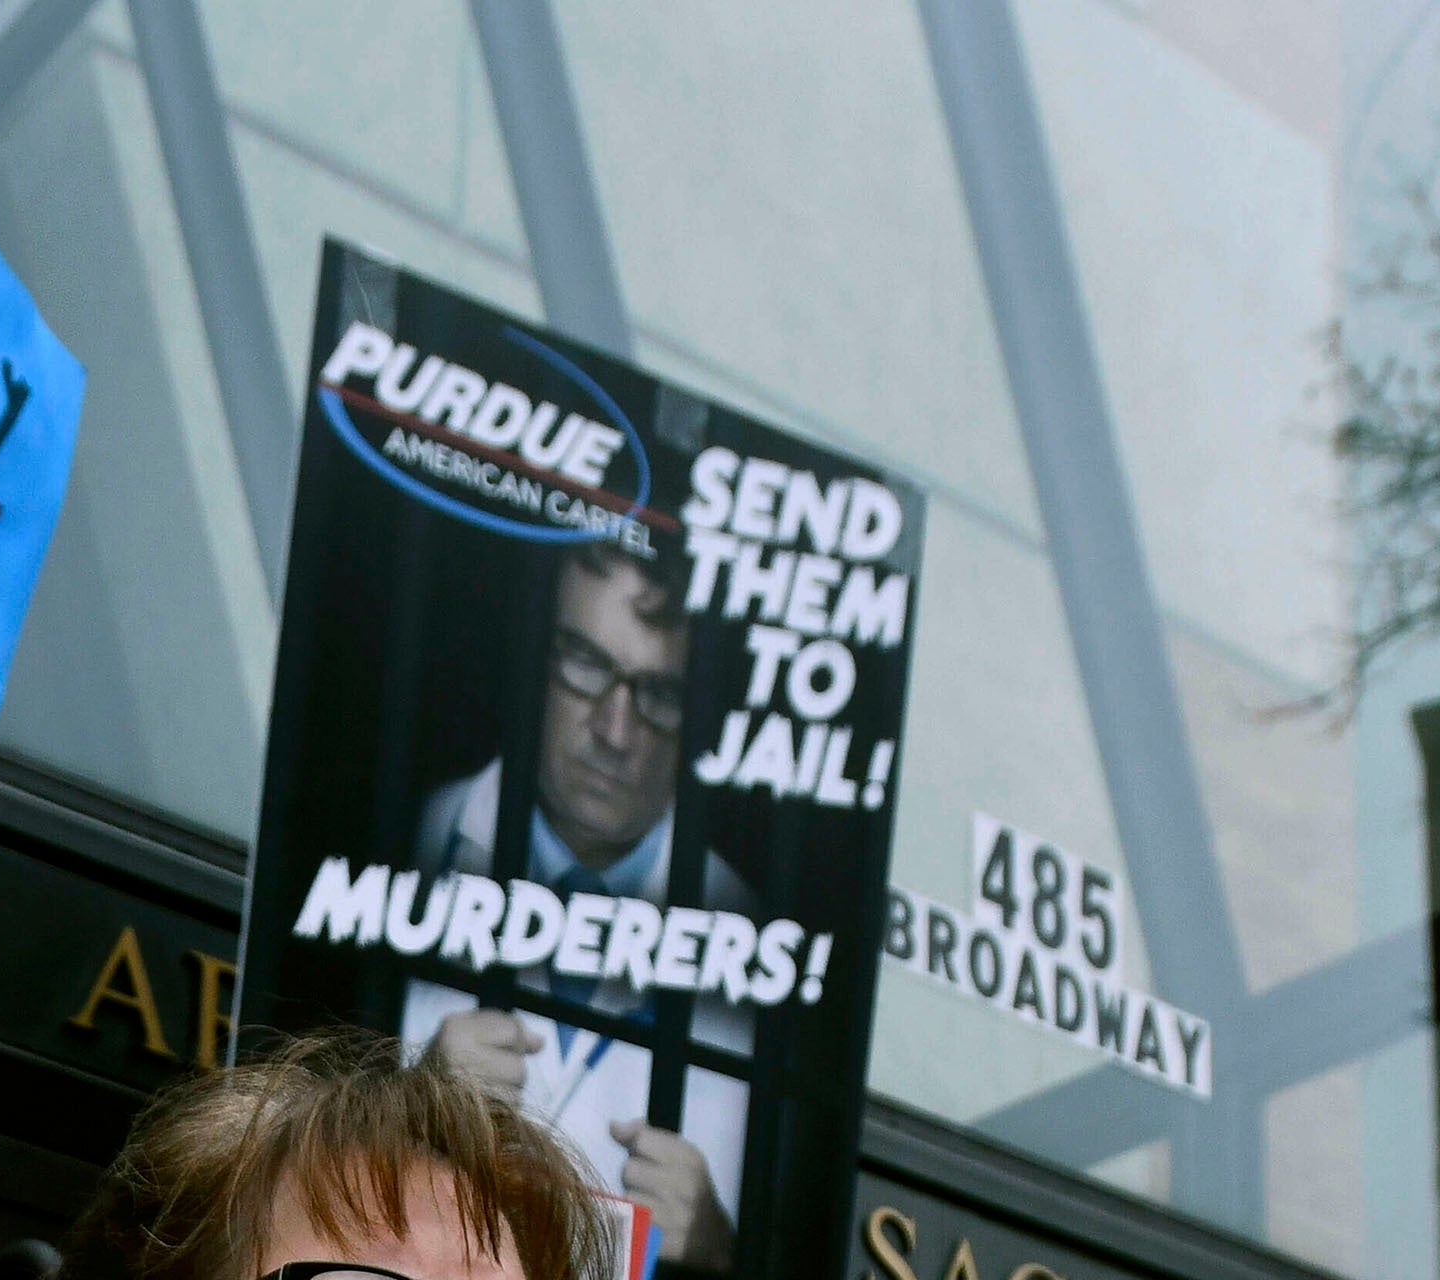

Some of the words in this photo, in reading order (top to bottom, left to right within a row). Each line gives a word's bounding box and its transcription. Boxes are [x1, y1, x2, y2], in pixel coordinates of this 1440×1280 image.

[321, 320, 627, 488] PURDUE
[383, 426, 544, 514] AMERICAN
[545, 489, 658, 561] CARTEL
[683, 446, 902, 561] SEND
[685, 531, 910, 649] THEM
[745, 623, 857, 721] TO
[695, 710, 896, 811] JAIL!
[294, 855, 834, 1007] MURDERERS!
[981, 825, 1116, 969] 485
[884, 890, 1202, 1085] BROADWAY
